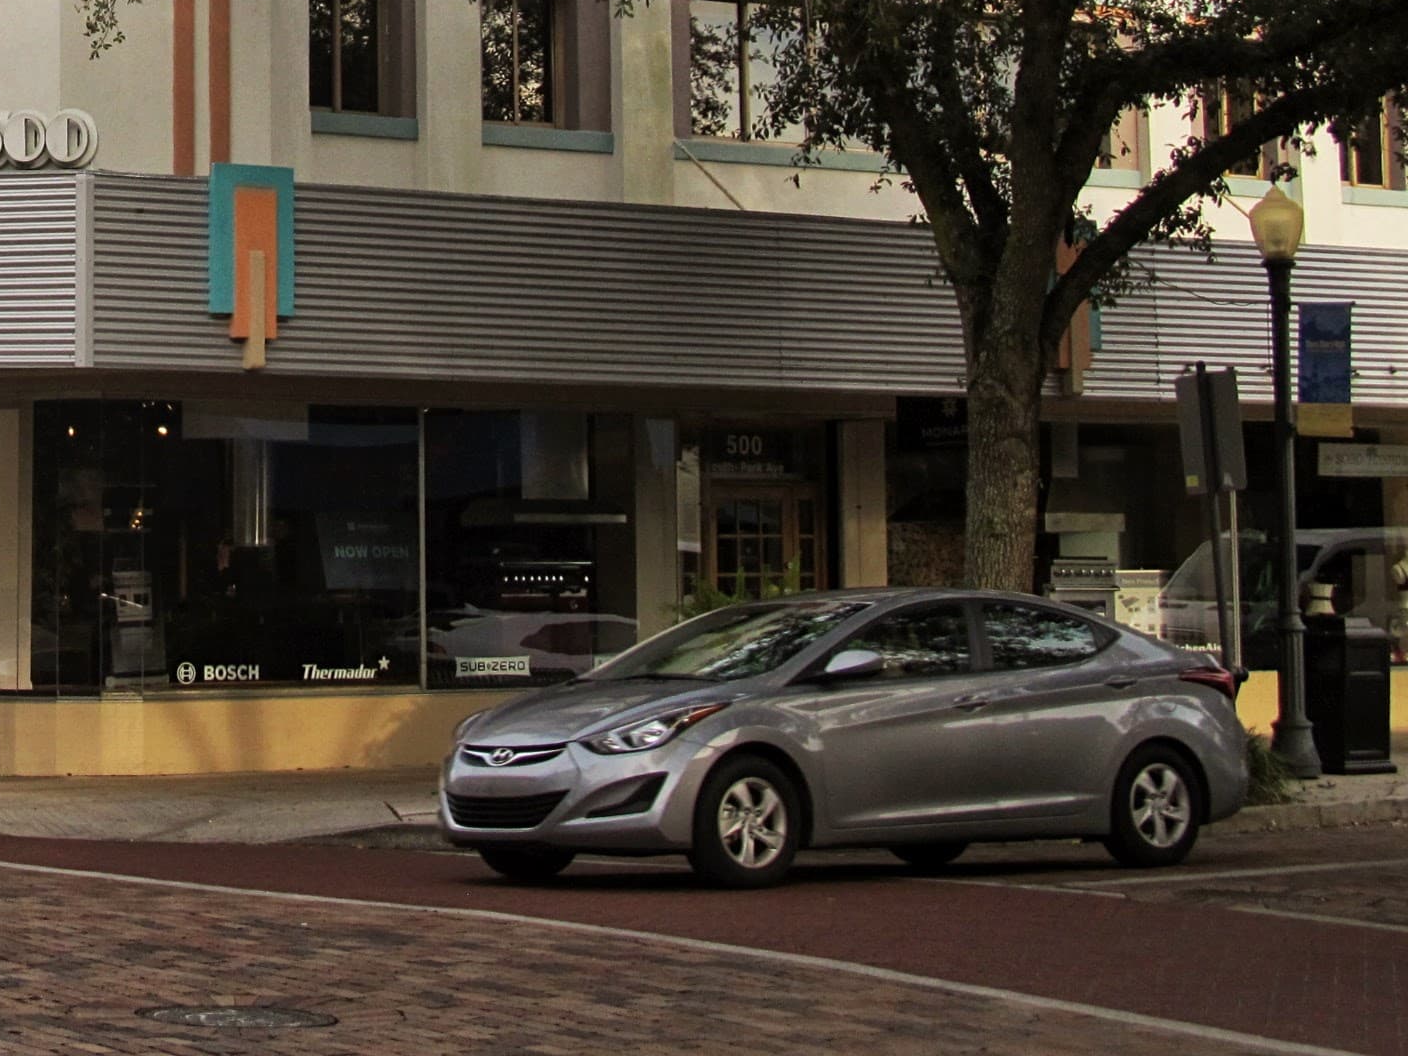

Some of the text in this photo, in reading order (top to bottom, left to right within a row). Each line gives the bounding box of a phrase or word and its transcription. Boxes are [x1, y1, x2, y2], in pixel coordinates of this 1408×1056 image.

[726, 434, 762, 455] 500
[334, 545, 409, 558] NOW OPEN
[203, 664, 260, 681] BOSCH
[302, 663, 378, 680] Thermador
